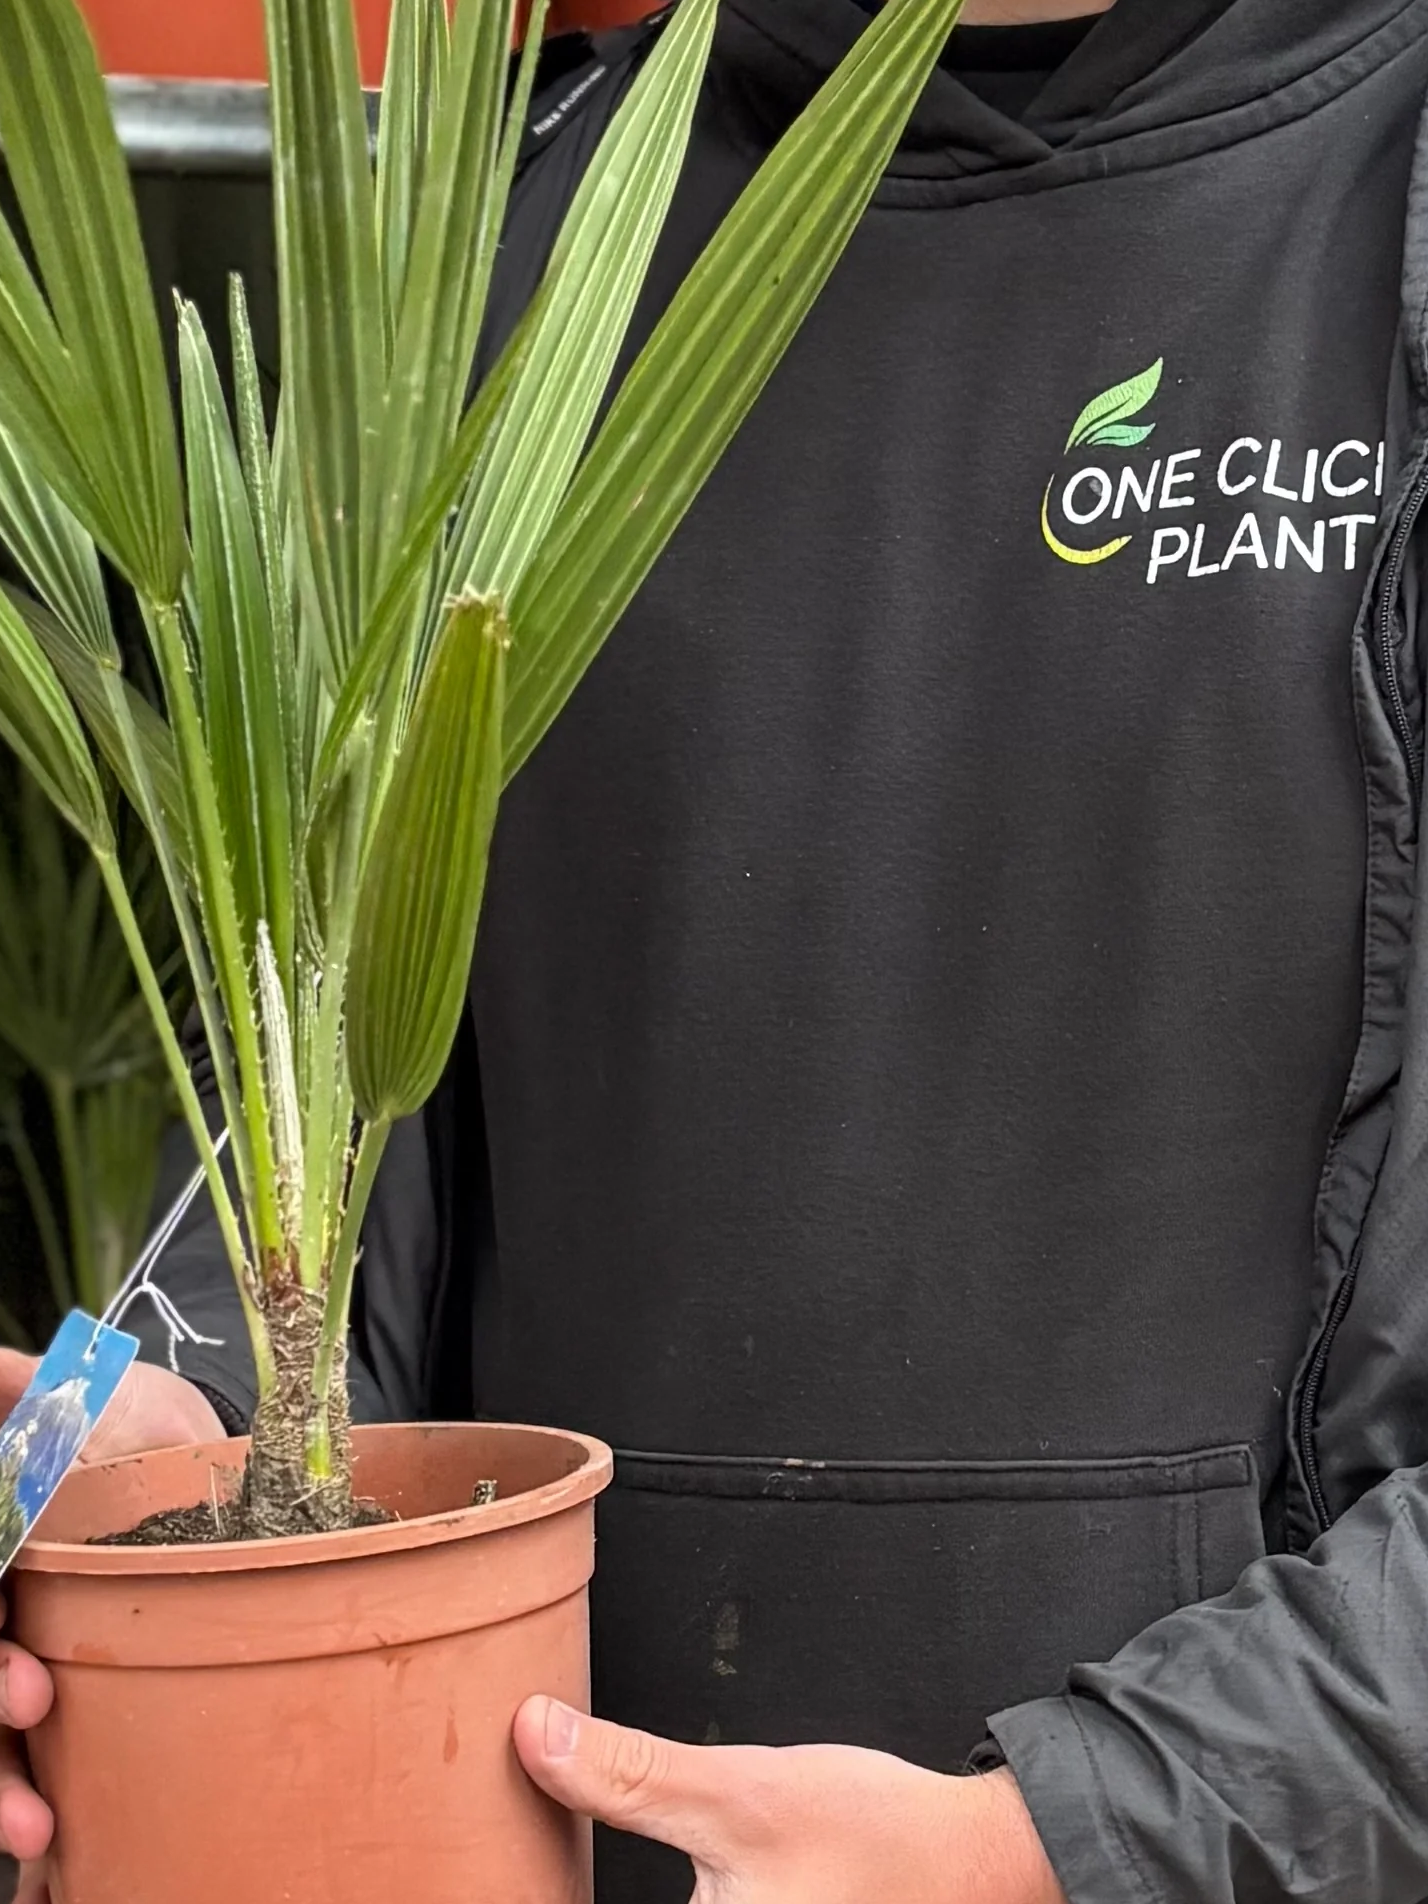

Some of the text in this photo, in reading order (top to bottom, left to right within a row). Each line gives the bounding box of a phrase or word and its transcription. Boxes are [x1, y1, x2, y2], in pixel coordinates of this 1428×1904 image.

[532, 108, 563, 136] NIKE
[1061, 448, 1202, 525] ONE
[1145, 512, 1376, 585] PLANT
